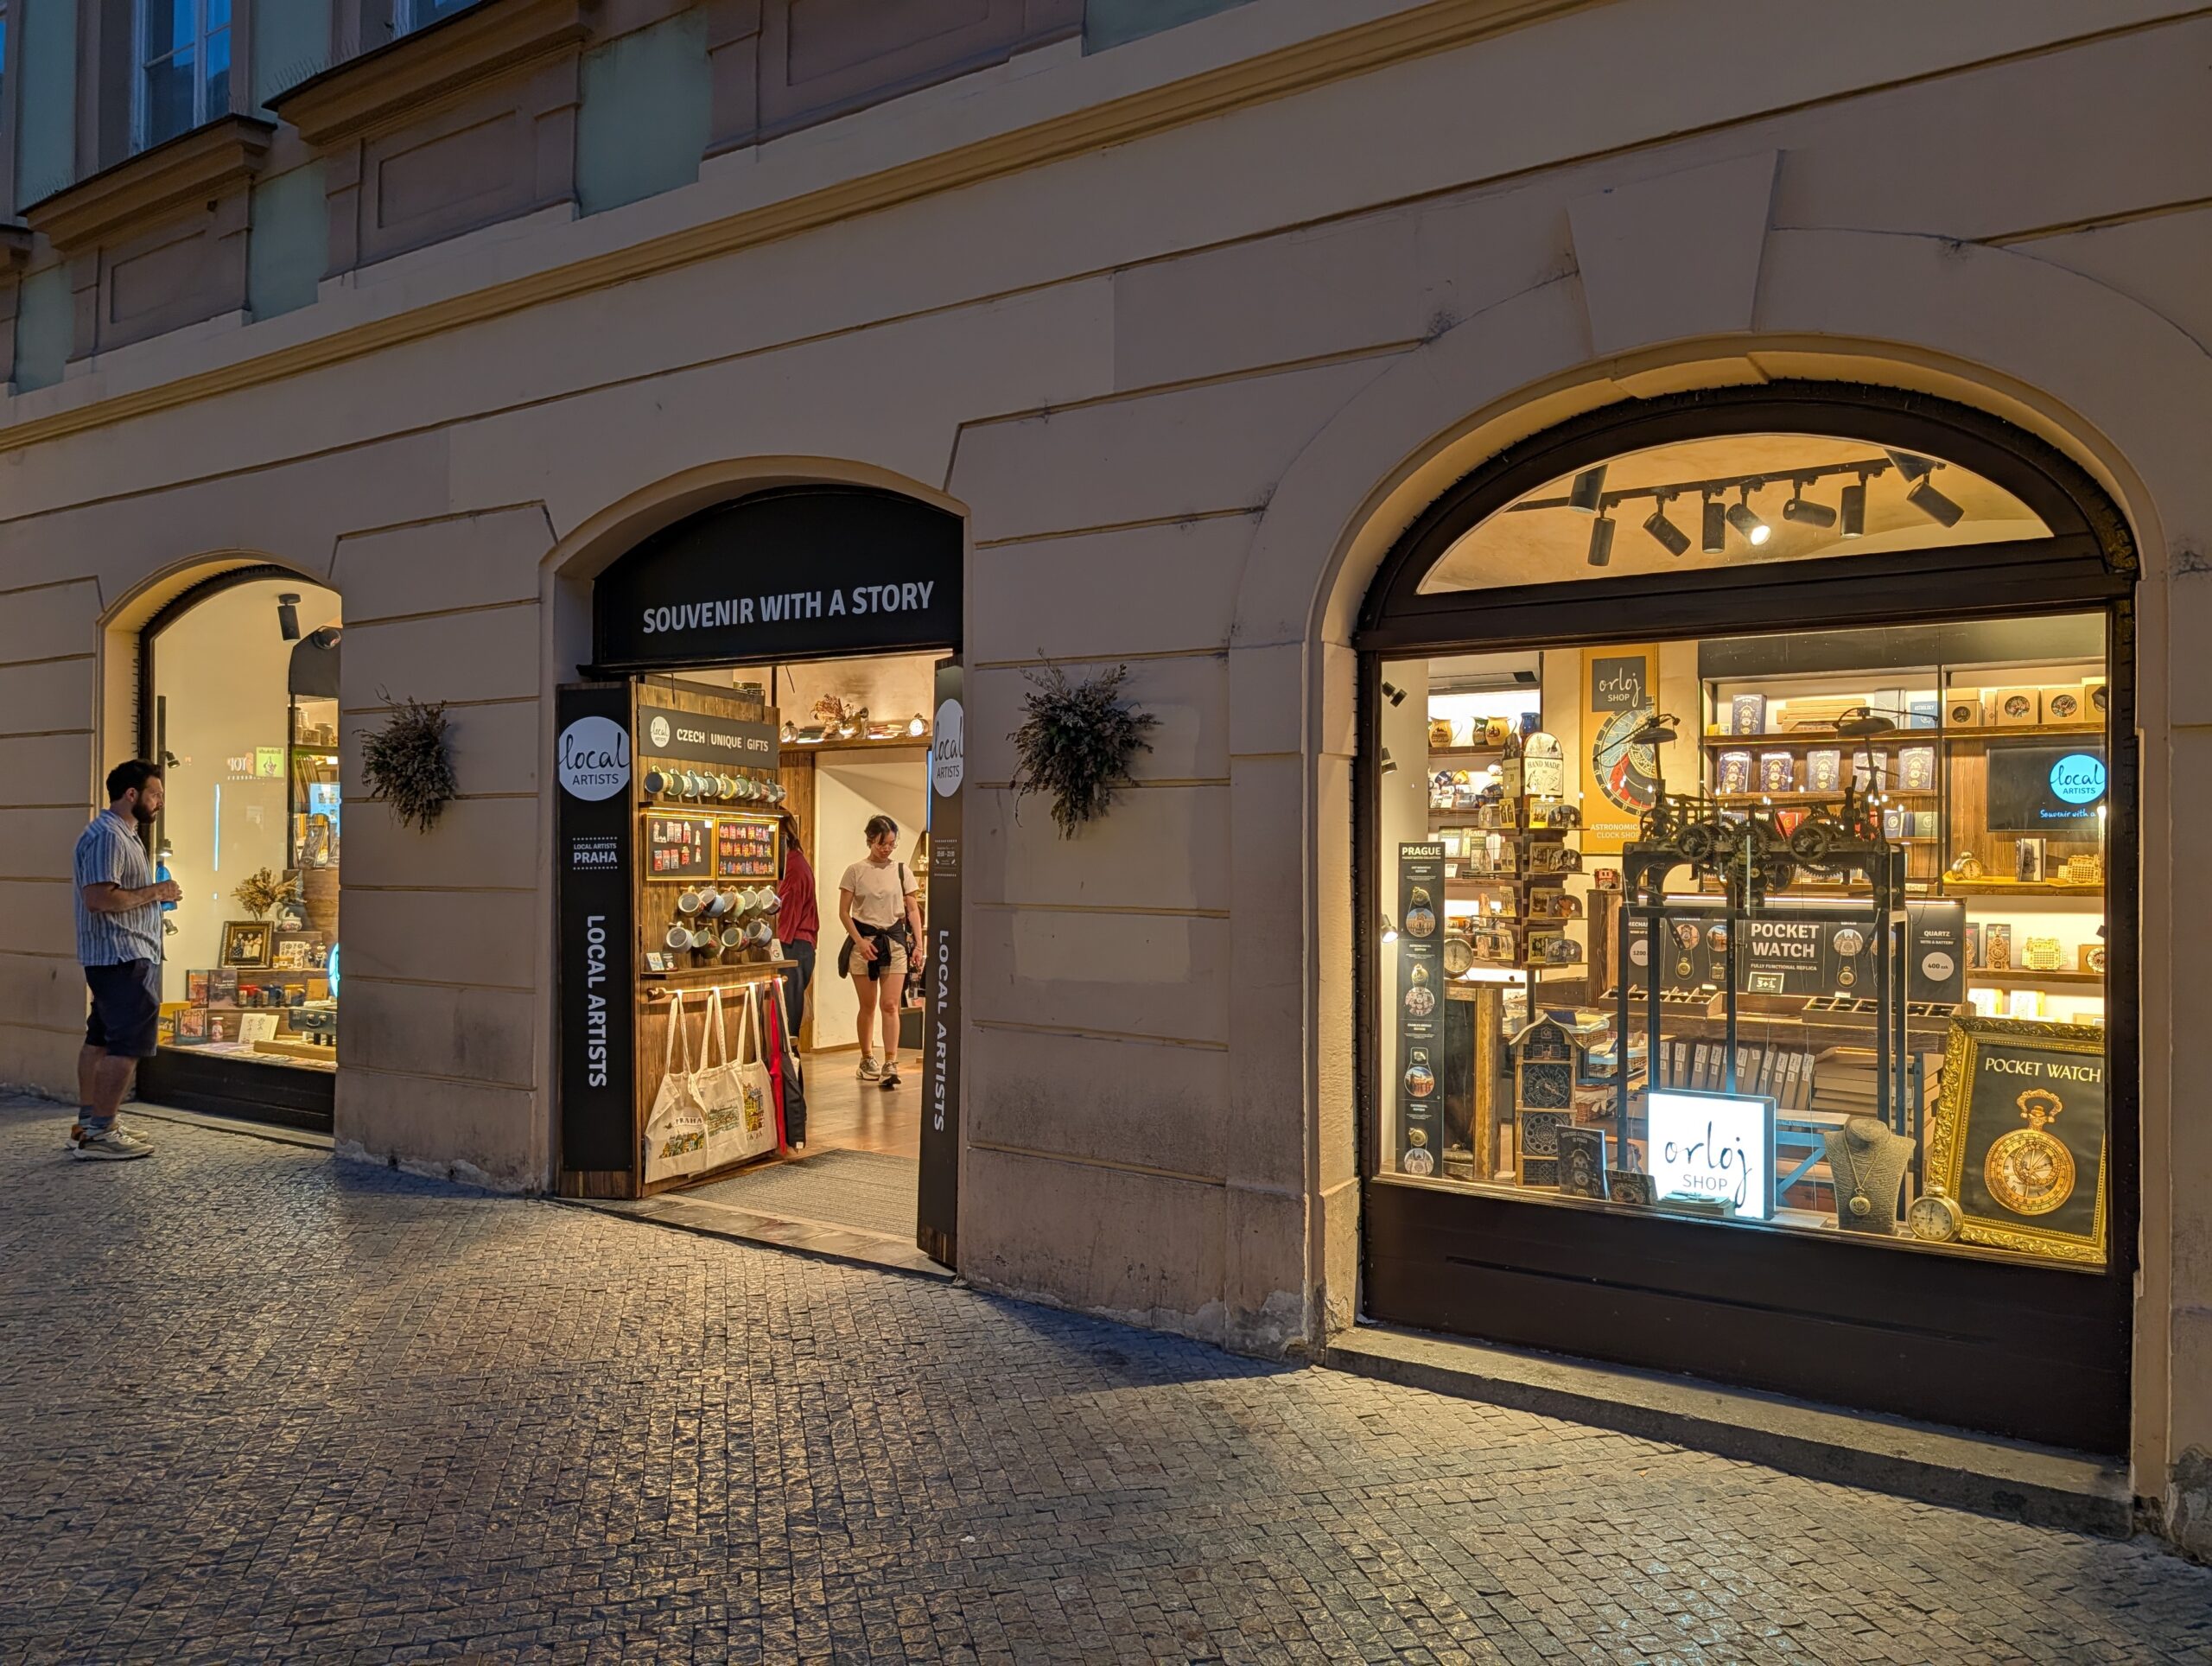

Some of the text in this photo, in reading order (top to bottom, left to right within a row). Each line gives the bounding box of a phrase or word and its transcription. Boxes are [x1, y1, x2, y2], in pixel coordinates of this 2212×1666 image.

[643, 581, 934, 633] SOUVENIR WITH A STORY
[1599, 667, 1642, 708] orloj
[1607, 693, 1630, 702] SHOP
[677, 728, 768, 752] CZECH UNIQUE GIFTS
[933, 715, 963, 761] local
[559, 732, 629, 770] local
[937, 766, 959, 779] ARTISTS
[1528, 760, 1543, 769] HAND
[1544, 761, 1560, 771] MADE
[2050, 764, 2104, 785] local
[572, 773, 619, 785] ARTISTS
[2040, 809, 2071, 818] Souvenir
[2072, 808, 2088, 817] with
[574, 851, 617, 863] PRAHA
[1402, 847, 1441, 855] PRAGUE
[1751, 923, 1820, 939] POCKET
[1752, 942, 1815, 957] WATCH
[588, 915, 607, 1087] LOCAL ARTISTS
[934, 930, 949, 1132] LOCAL ARTISTS
[1985, 1057, 2101, 1083] POCKET WATCH
[1665, 1121, 1752, 1208] orloj
[1682, 1173, 1727, 1191] SHOP
